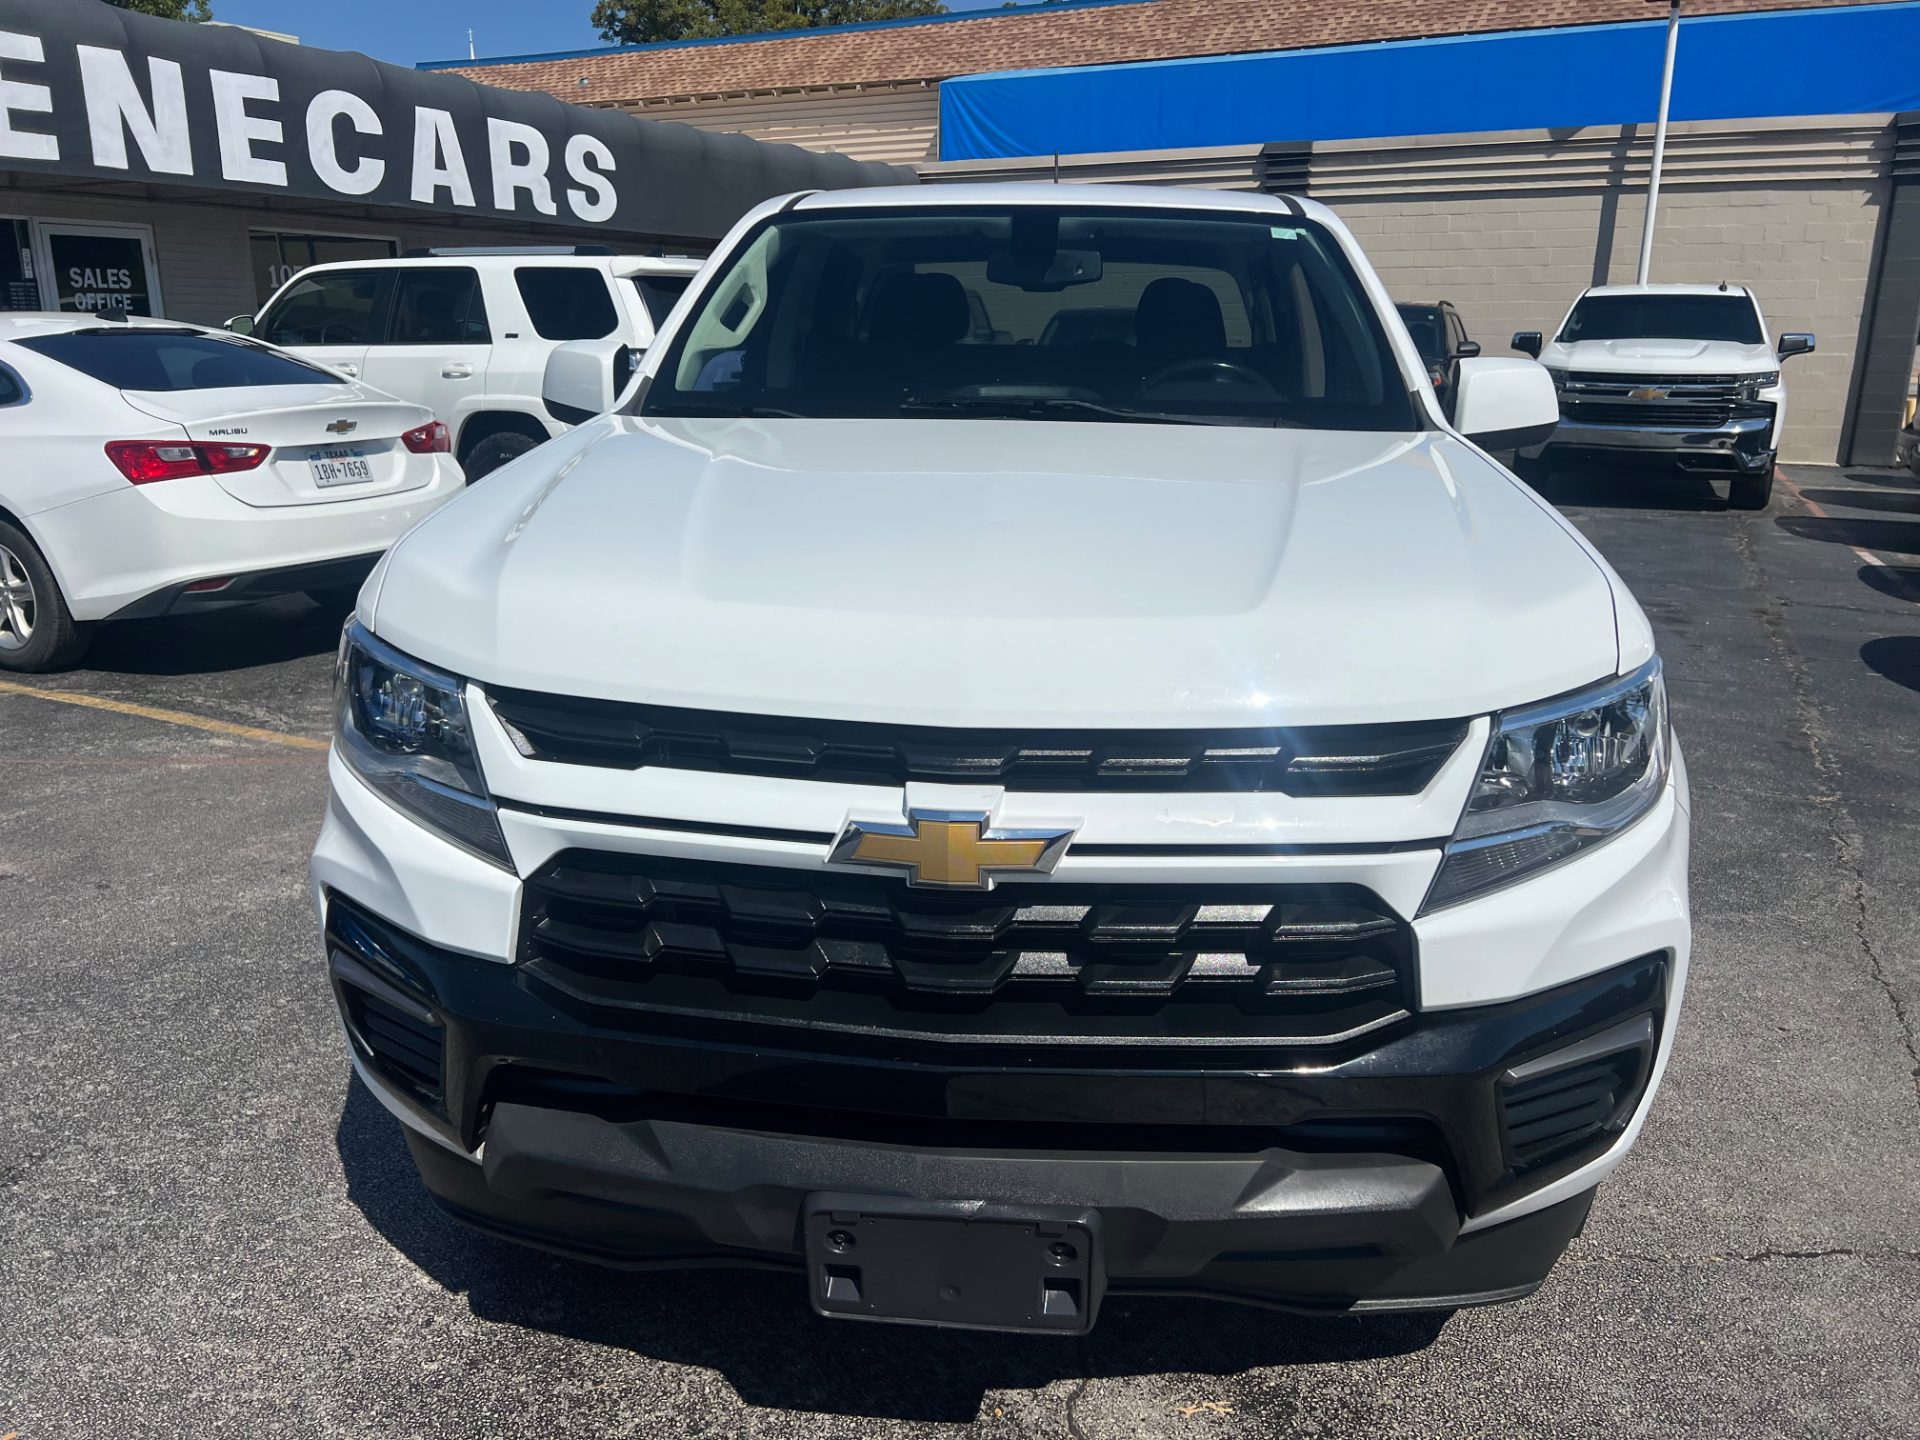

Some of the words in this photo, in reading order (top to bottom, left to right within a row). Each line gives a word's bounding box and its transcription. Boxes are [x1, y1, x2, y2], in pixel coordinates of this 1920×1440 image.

[69, 267, 131, 289] SALES
[74, 292, 133, 310] OFFICE
[209, 428, 248, 436] MALIBU
[325, 450, 348, 459] TEXAS
